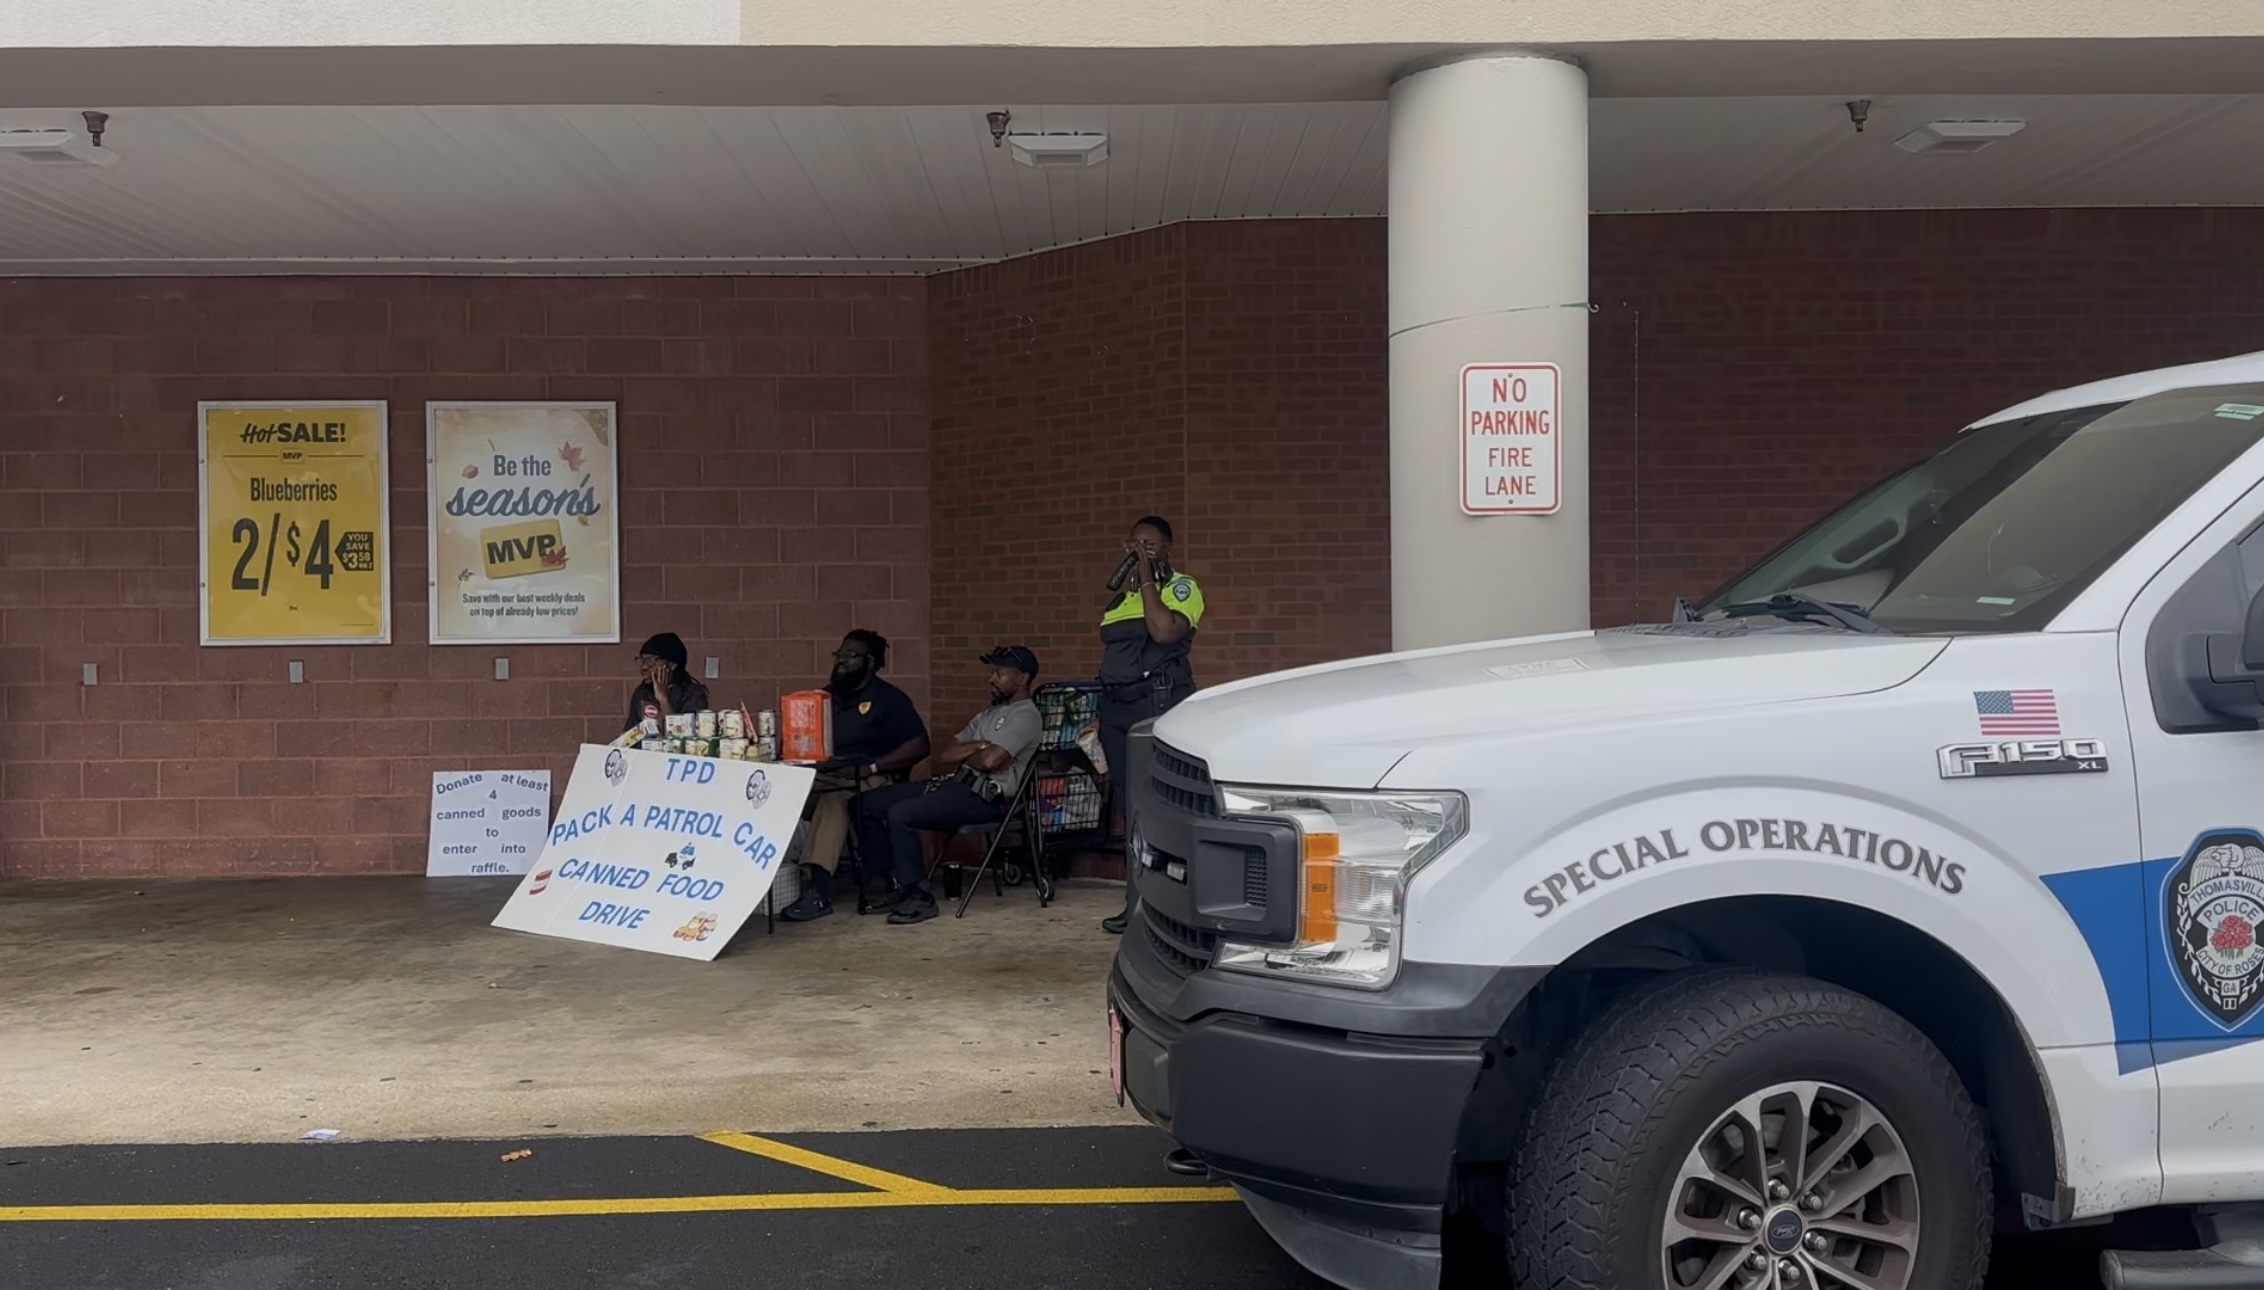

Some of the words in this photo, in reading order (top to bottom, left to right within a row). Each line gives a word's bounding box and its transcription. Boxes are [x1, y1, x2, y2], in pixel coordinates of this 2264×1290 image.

[1492, 378, 1527, 403] NO
[240, 422, 278, 444] Hot
[277, 422, 346, 443] SALE!
[1471, 410, 1550, 436] PARKING
[282, 452, 303, 460] MVP
[493, 454, 518, 477] Be
[521, 454, 552, 477] the
[1488, 447, 1533, 468] FIRE
[250, 477, 338, 502] Blueberries
[445, 473, 601, 517] season's
[1485, 475, 1537, 496] LANE
[345, 542, 370, 550] SAVE
[347, 533, 369, 542] YOU
[486, 533, 557, 565] MVP
[462, 593, 482, 603] Save
[482, 593, 501, 603] with
[501, 595, 516, 603] our
[516, 593, 535, 603] best
[535, 592, 563, 604] weekly
[563, 592, 586, 603] deals
[469, 608, 480, 617] on
[480, 607, 495, 618] top
[495, 606, 505, 616] of
[505, 606, 535, 618] already
[535, 606, 550, 616] low
[550, 605, 579, 617] prices!
[666, 757, 716, 785] TPD
[2077, 760, 2103, 770] XL
[436, 773, 483, 795] Donate
[500, 773, 515, 785] at
[516, 775, 549, 792] least
[488, 789, 498, 800] 4
[436, 807, 486, 821] canned
[501, 806, 542, 821] goods
[485, 827, 500, 838] to
[552, 803, 614, 847] PACK
[619, 803, 637, 828] A
[643, 804, 724, 839] PATROL
[732, 821, 778, 871] CAR
[442, 844, 478, 855] enter
[500, 843, 527, 854] into
[471, 861, 510, 873] raffle.
[1522, 828, 1690, 919] SPECIAL
[1700, 818, 1967, 896] OPERATIONS
[557, 857, 651, 890] CANNED
[655, 873, 725, 902] FOOD
[2190, 879, 2264, 904] THOMASVILL
[578, 900, 652, 930] DRIVE
[2203, 900, 2260, 923] POLICE
[2197, 949, 2219, 971] CITY
[2218, 964, 2232, 976] OF
[2234, 946, 2264, 975] ROSES
[2223, 982, 2237, 994] GA
